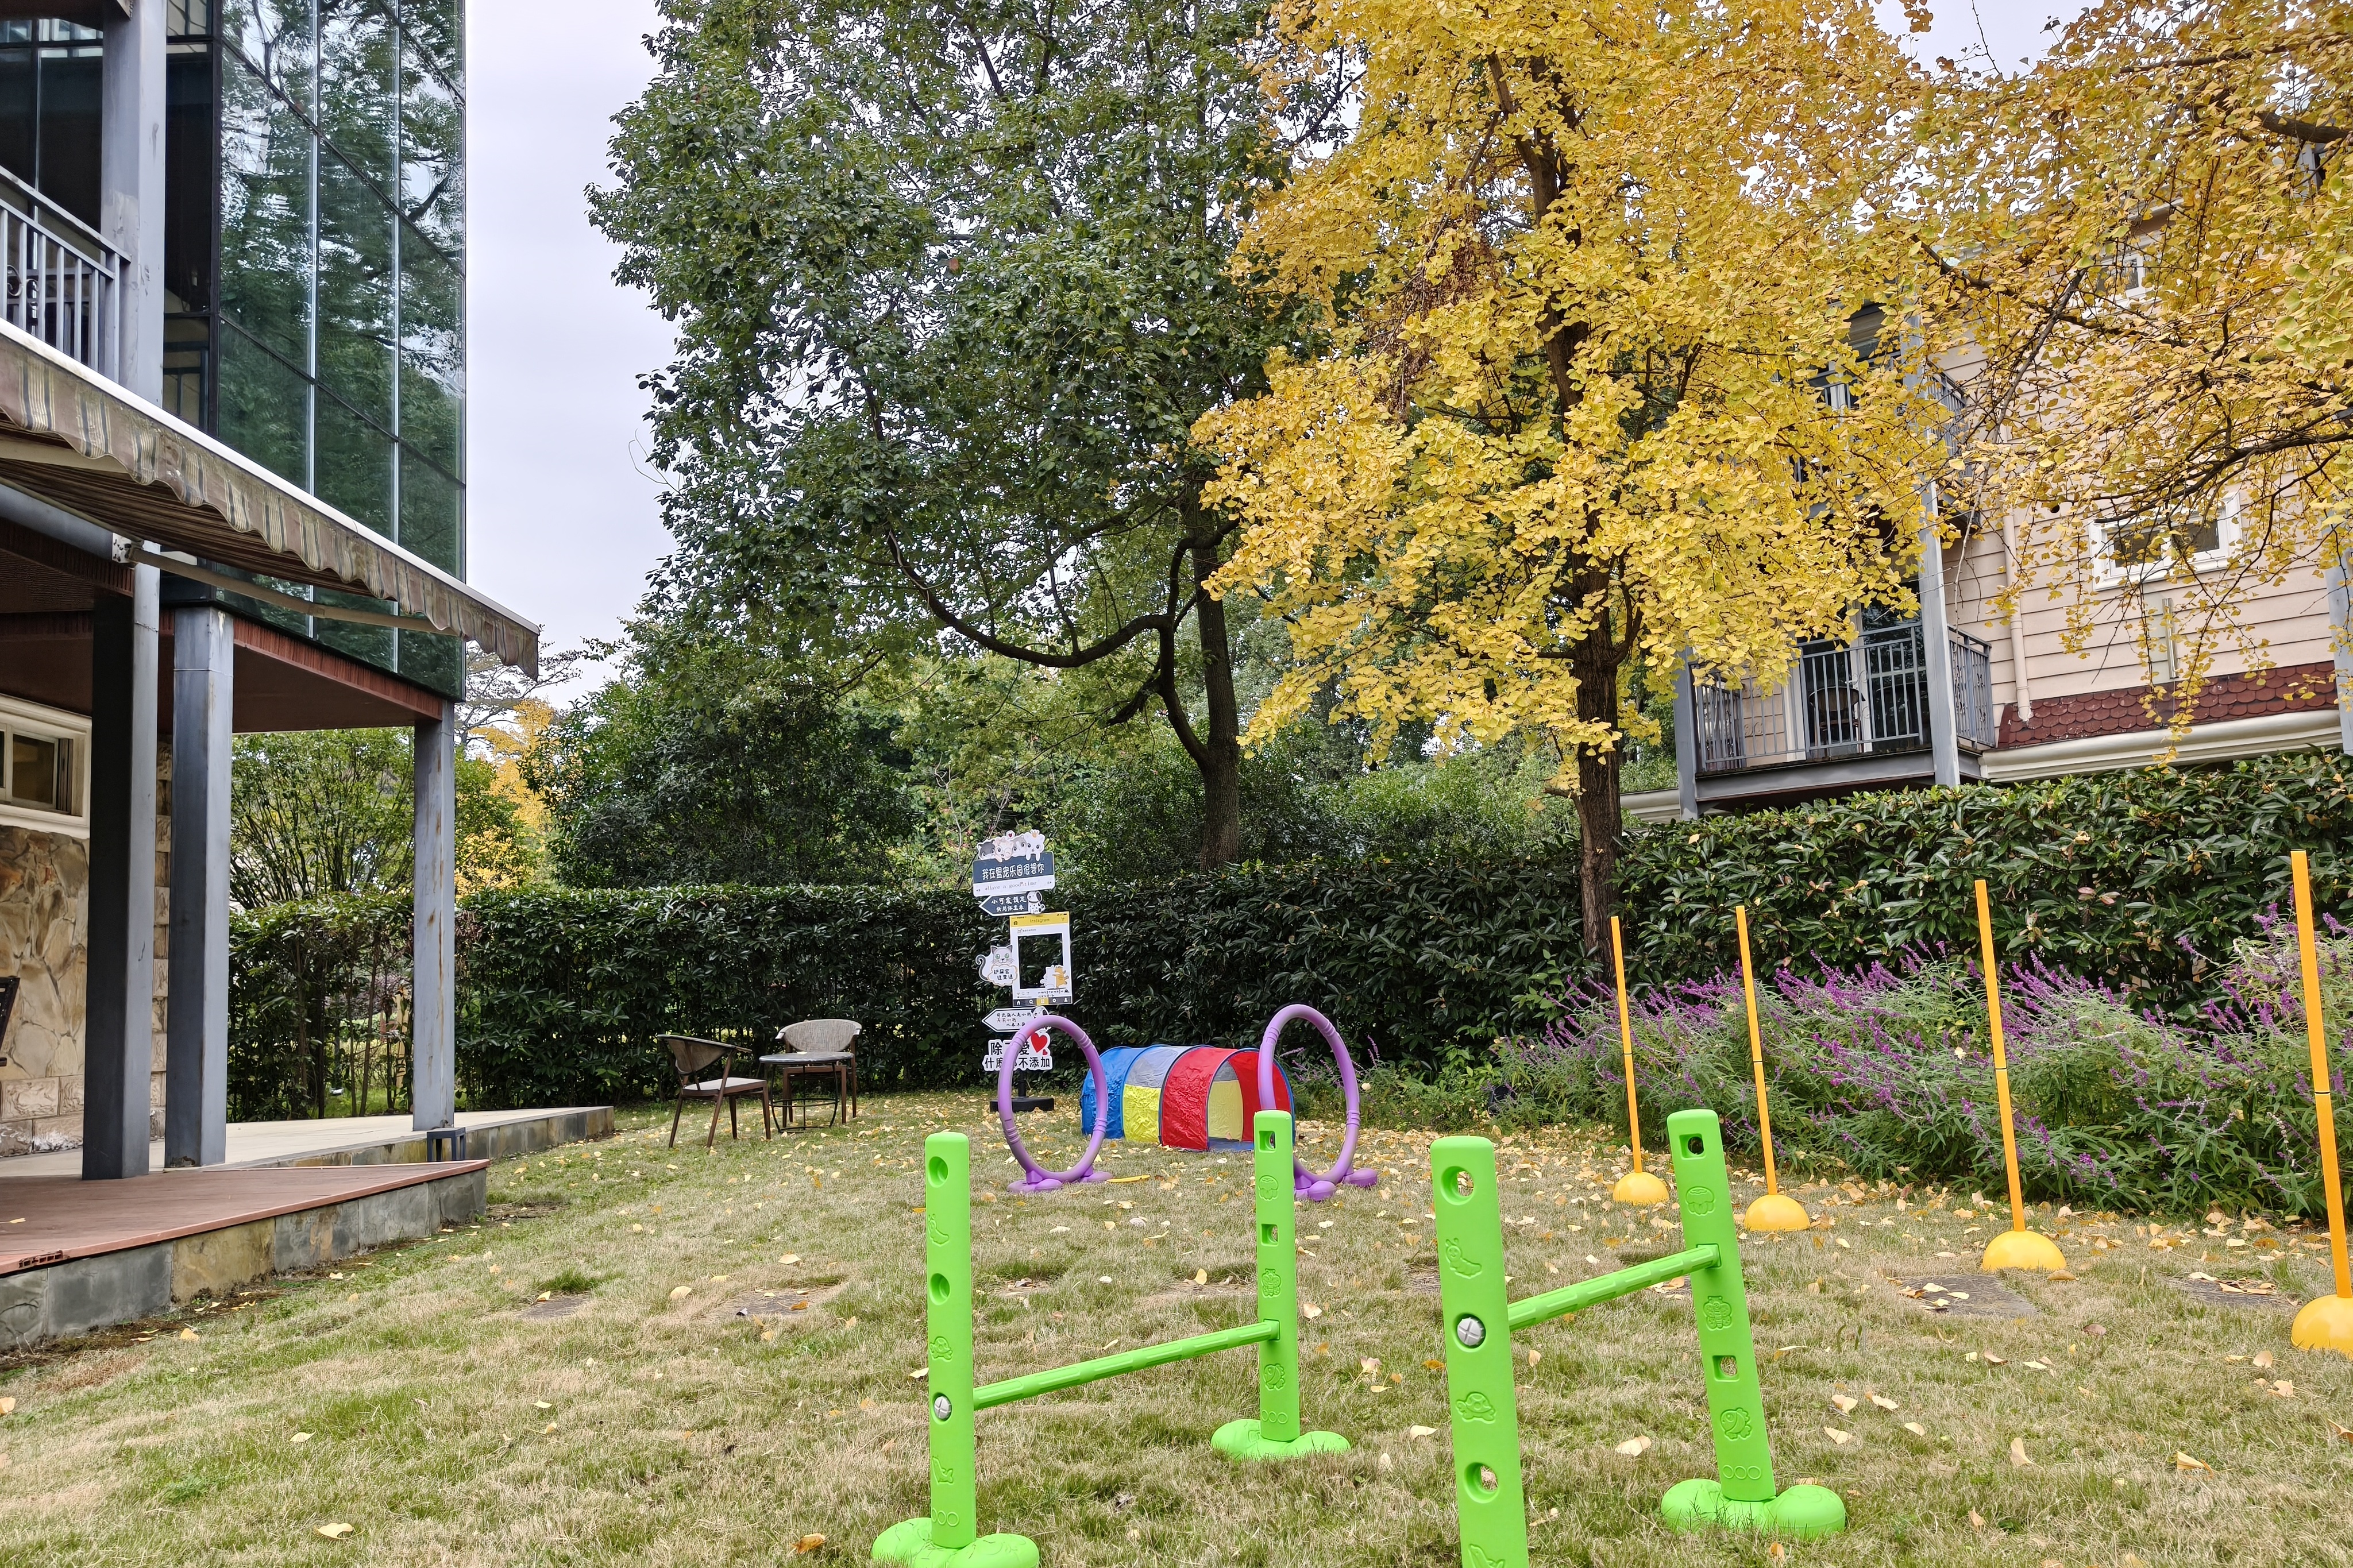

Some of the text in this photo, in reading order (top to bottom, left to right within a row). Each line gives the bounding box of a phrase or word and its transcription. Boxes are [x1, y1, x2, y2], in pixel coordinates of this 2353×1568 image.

[990, 1041, 1029, 1056] 除爱
[985, 1057, 1050, 1069] 什不添加
